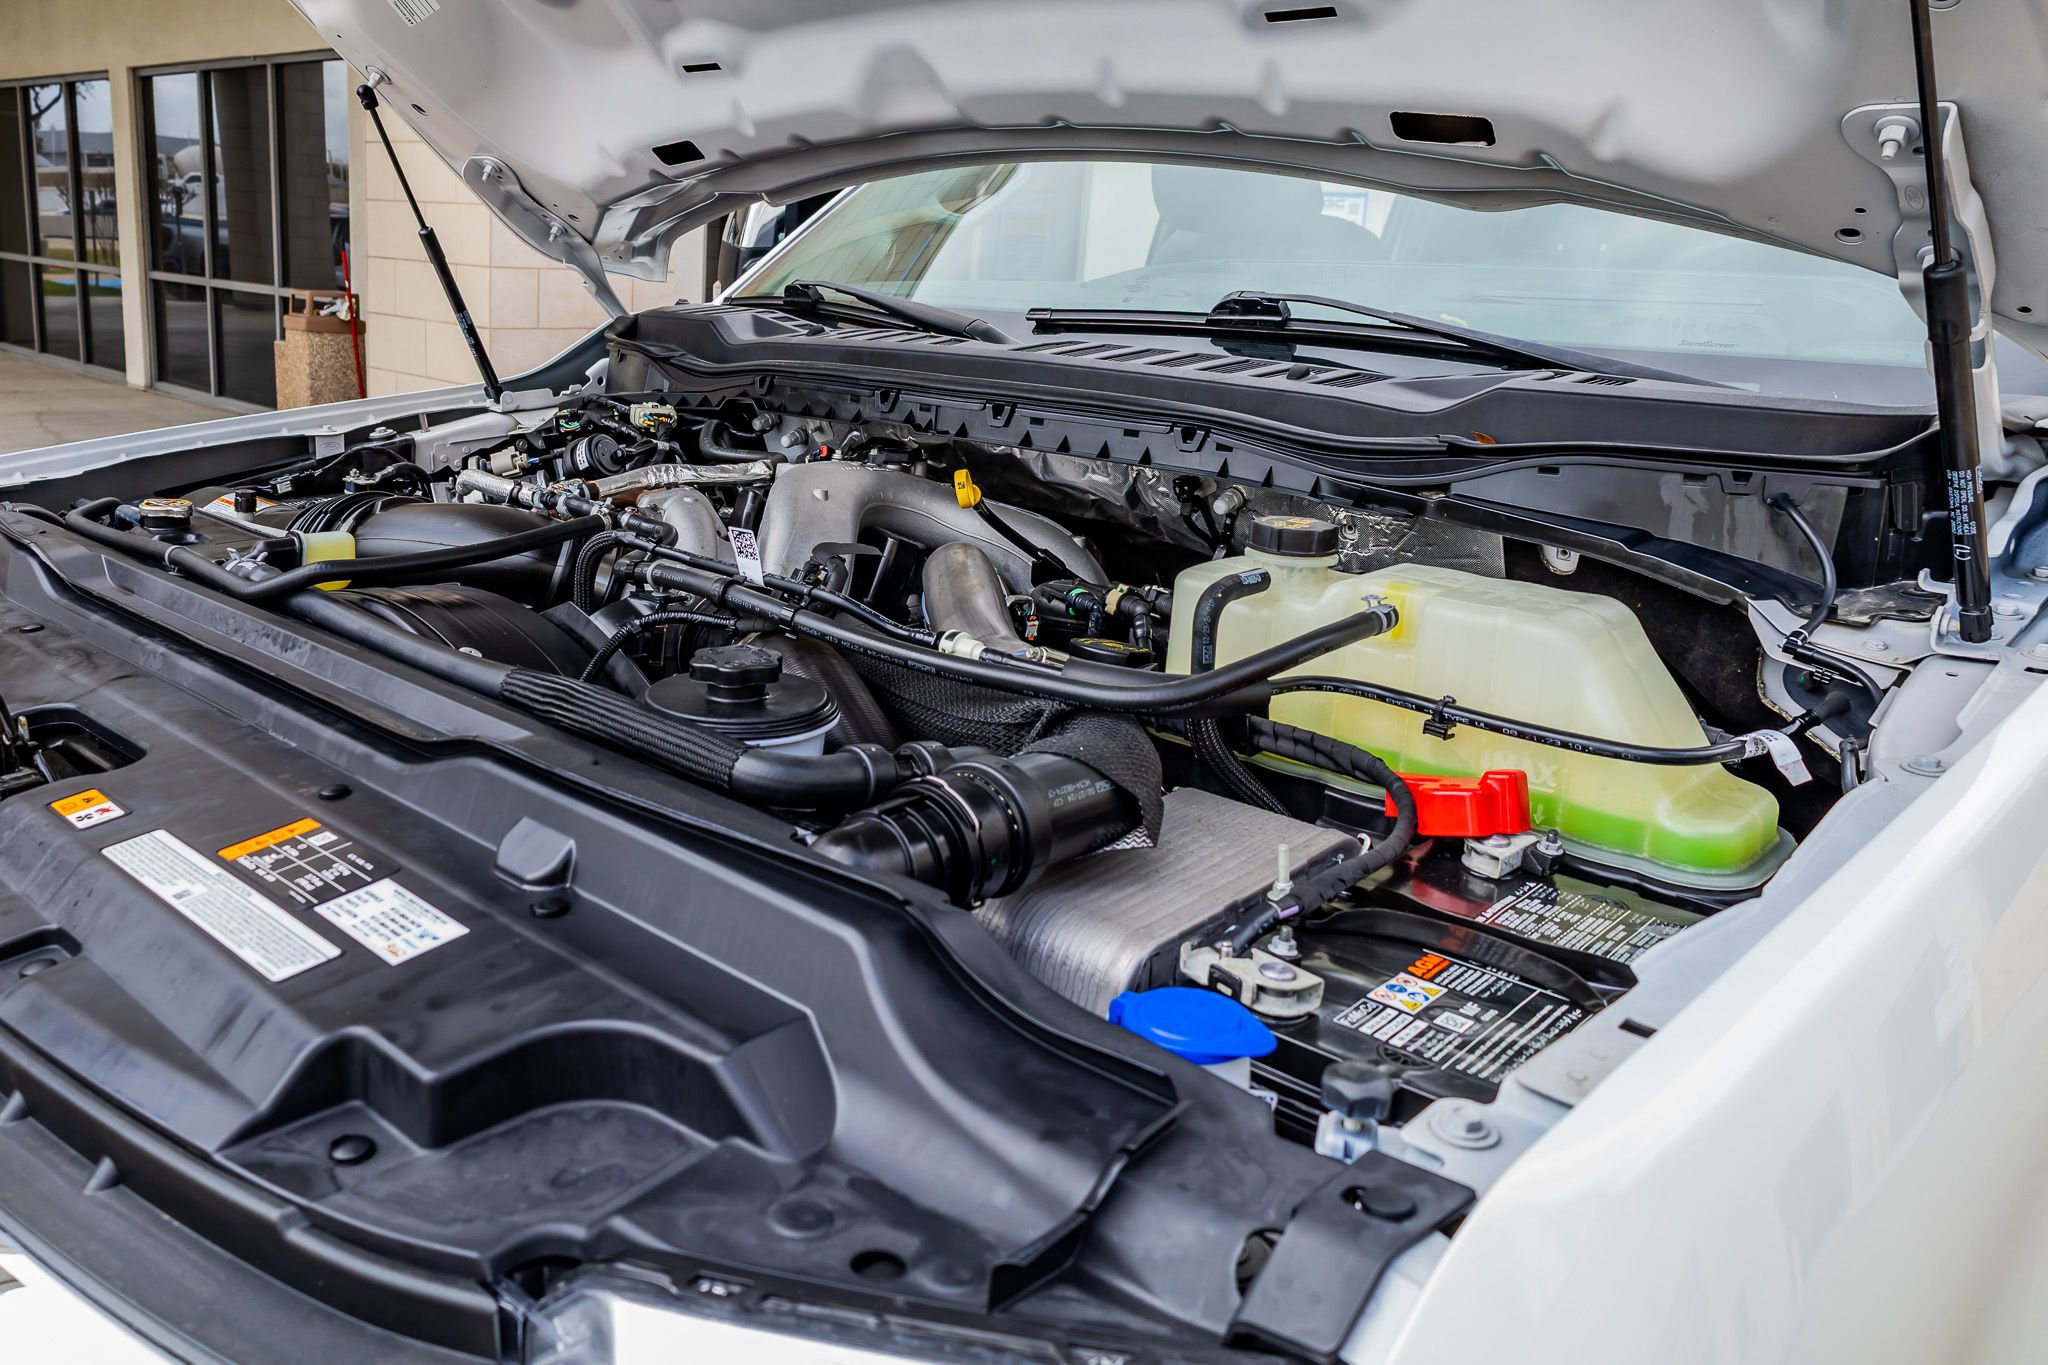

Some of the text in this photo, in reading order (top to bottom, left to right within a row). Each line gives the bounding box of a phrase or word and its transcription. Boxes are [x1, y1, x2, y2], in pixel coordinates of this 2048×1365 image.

[1678, 339, 1736, 349] SoundScreen
[1443, 712, 1470, 726] TYPE
[1407, 953, 1445, 976] AGM
[1339, 1001, 1378, 1026] FoMoCo
